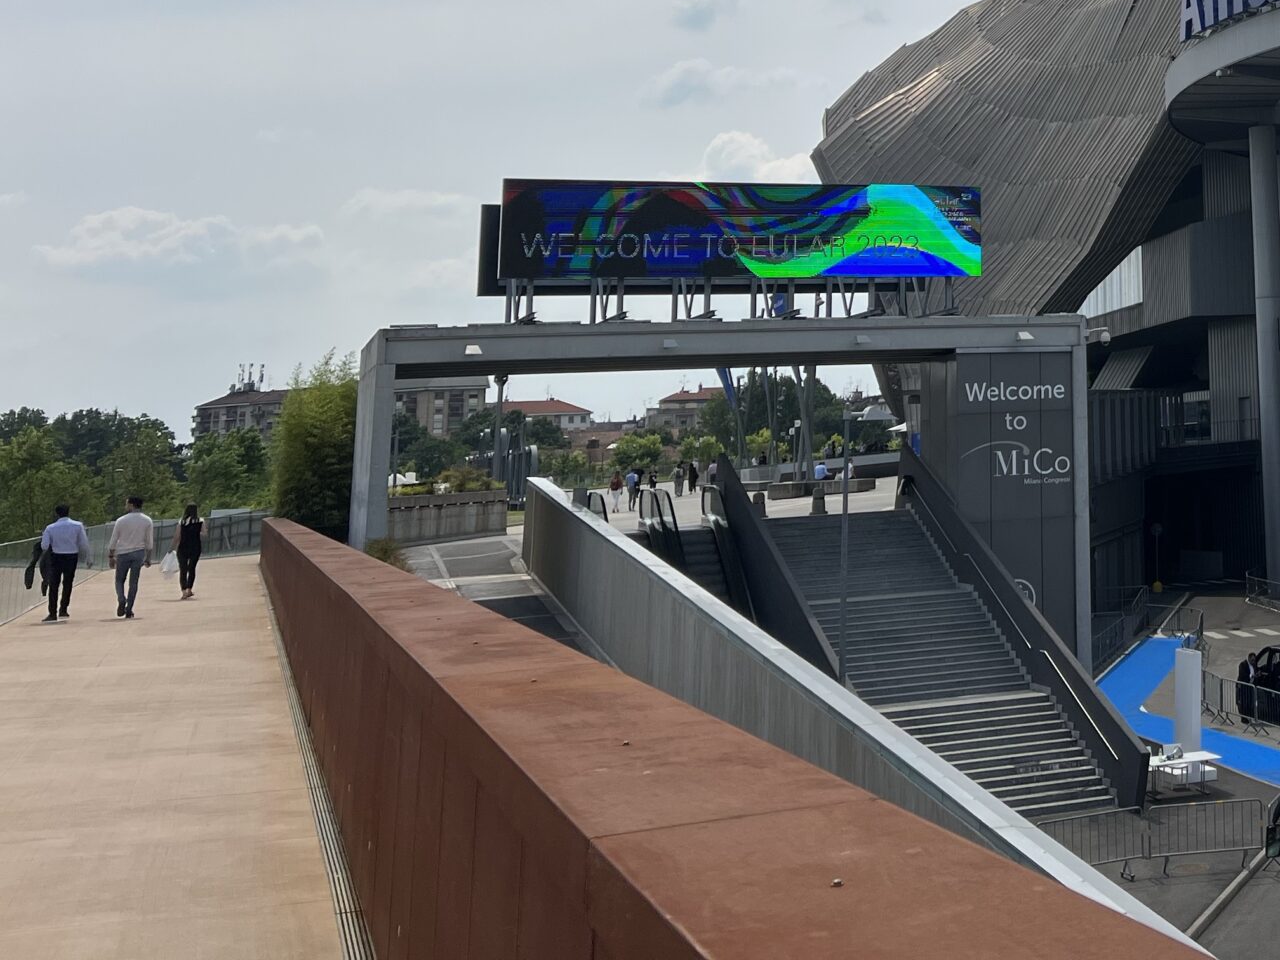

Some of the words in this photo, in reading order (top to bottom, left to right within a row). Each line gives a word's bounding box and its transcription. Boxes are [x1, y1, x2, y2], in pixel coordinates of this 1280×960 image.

[520, 232, 690, 258] WELCOME
[700, 233, 738, 258] TO
[752, 233, 845, 258] EULAR
[857, 234, 920, 258] 2023
[965, 381, 1065, 402] Welcome
[1005, 413, 1027, 430] to
[992, 447, 1070, 477] MiCo
